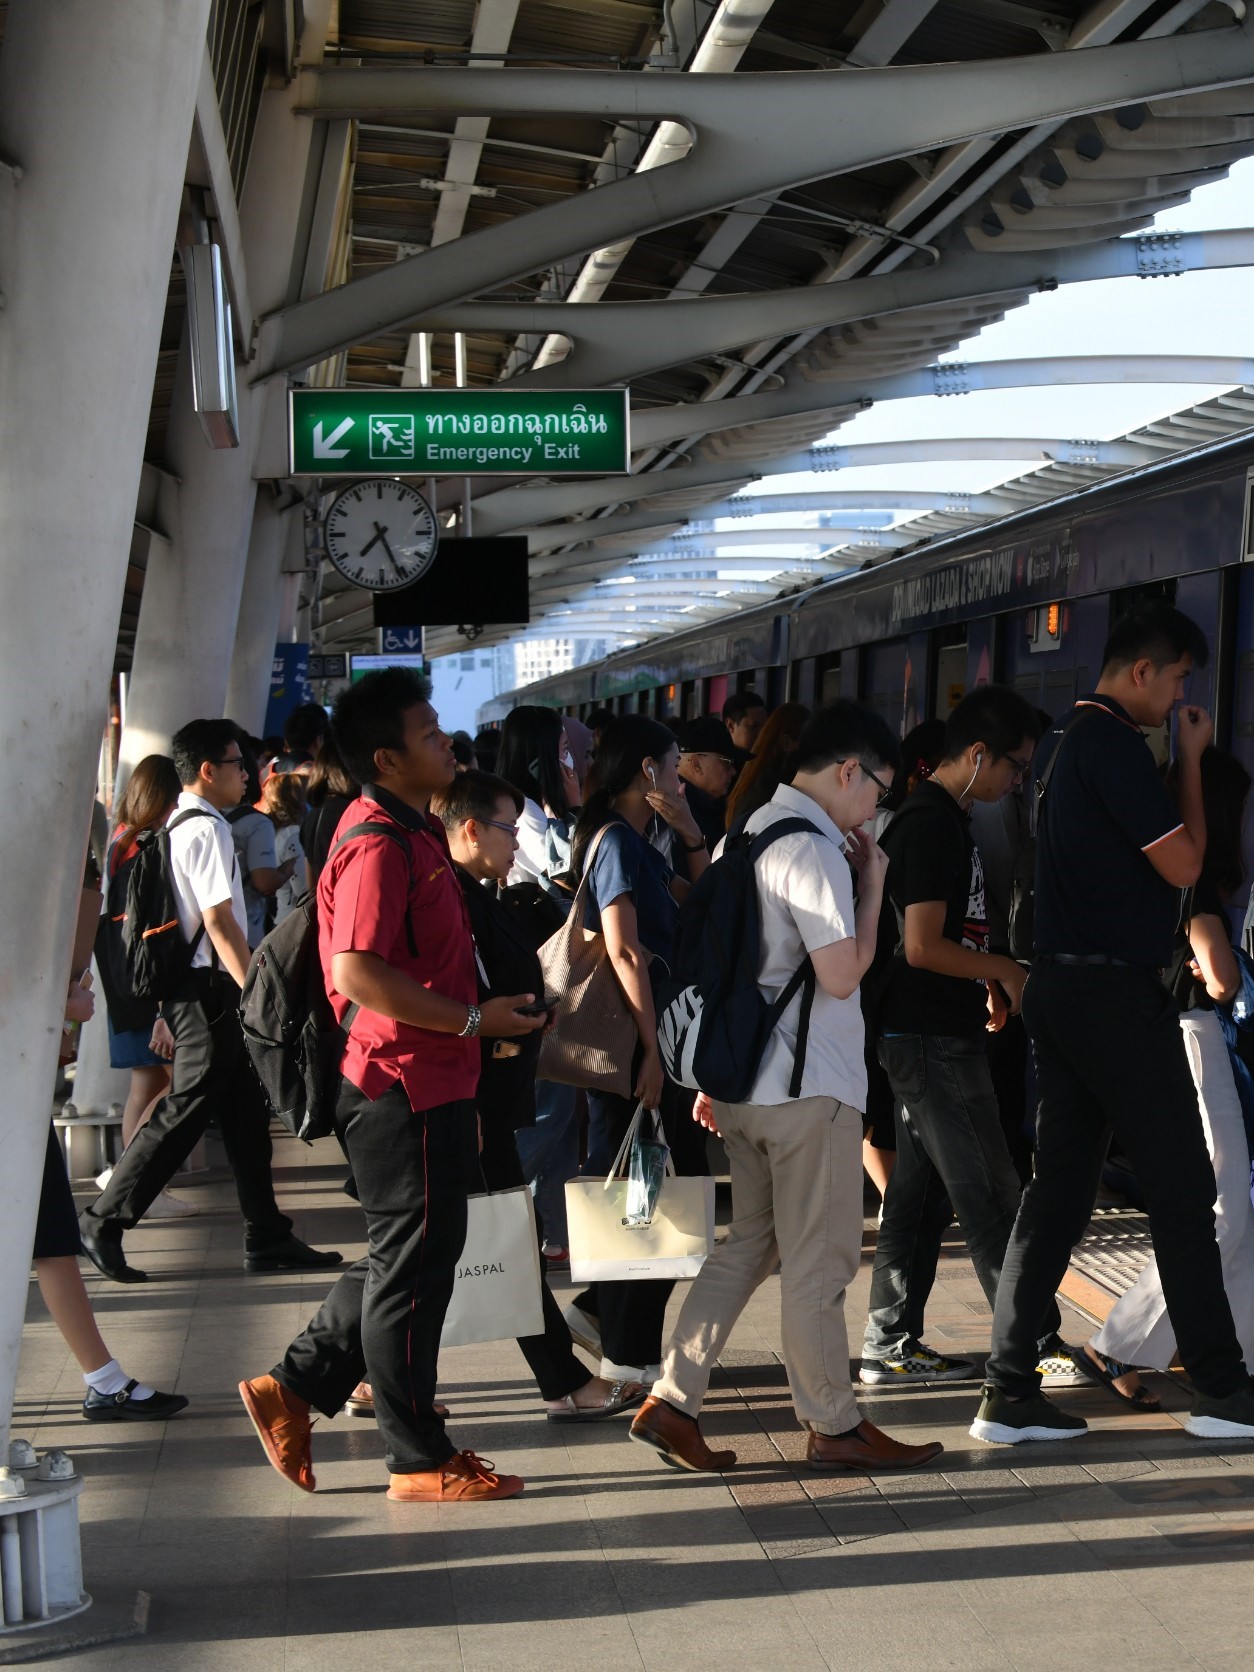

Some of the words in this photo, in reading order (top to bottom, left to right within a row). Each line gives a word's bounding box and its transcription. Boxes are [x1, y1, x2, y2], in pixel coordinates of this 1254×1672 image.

[425, 403, 608, 446] ทางออกฉุกเฉิน
[426, 443, 533, 464] Emergency
[544, 443, 581, 459] Exit
[892, 579, 930, 621] DOWNLOAD
[932, 568, 960, 612] LAZADA
[967, 557, 992, 604] SHOP
[990, 549, 1014, 597] NOW
[458, 1262, 505, 1279] JASPAL
